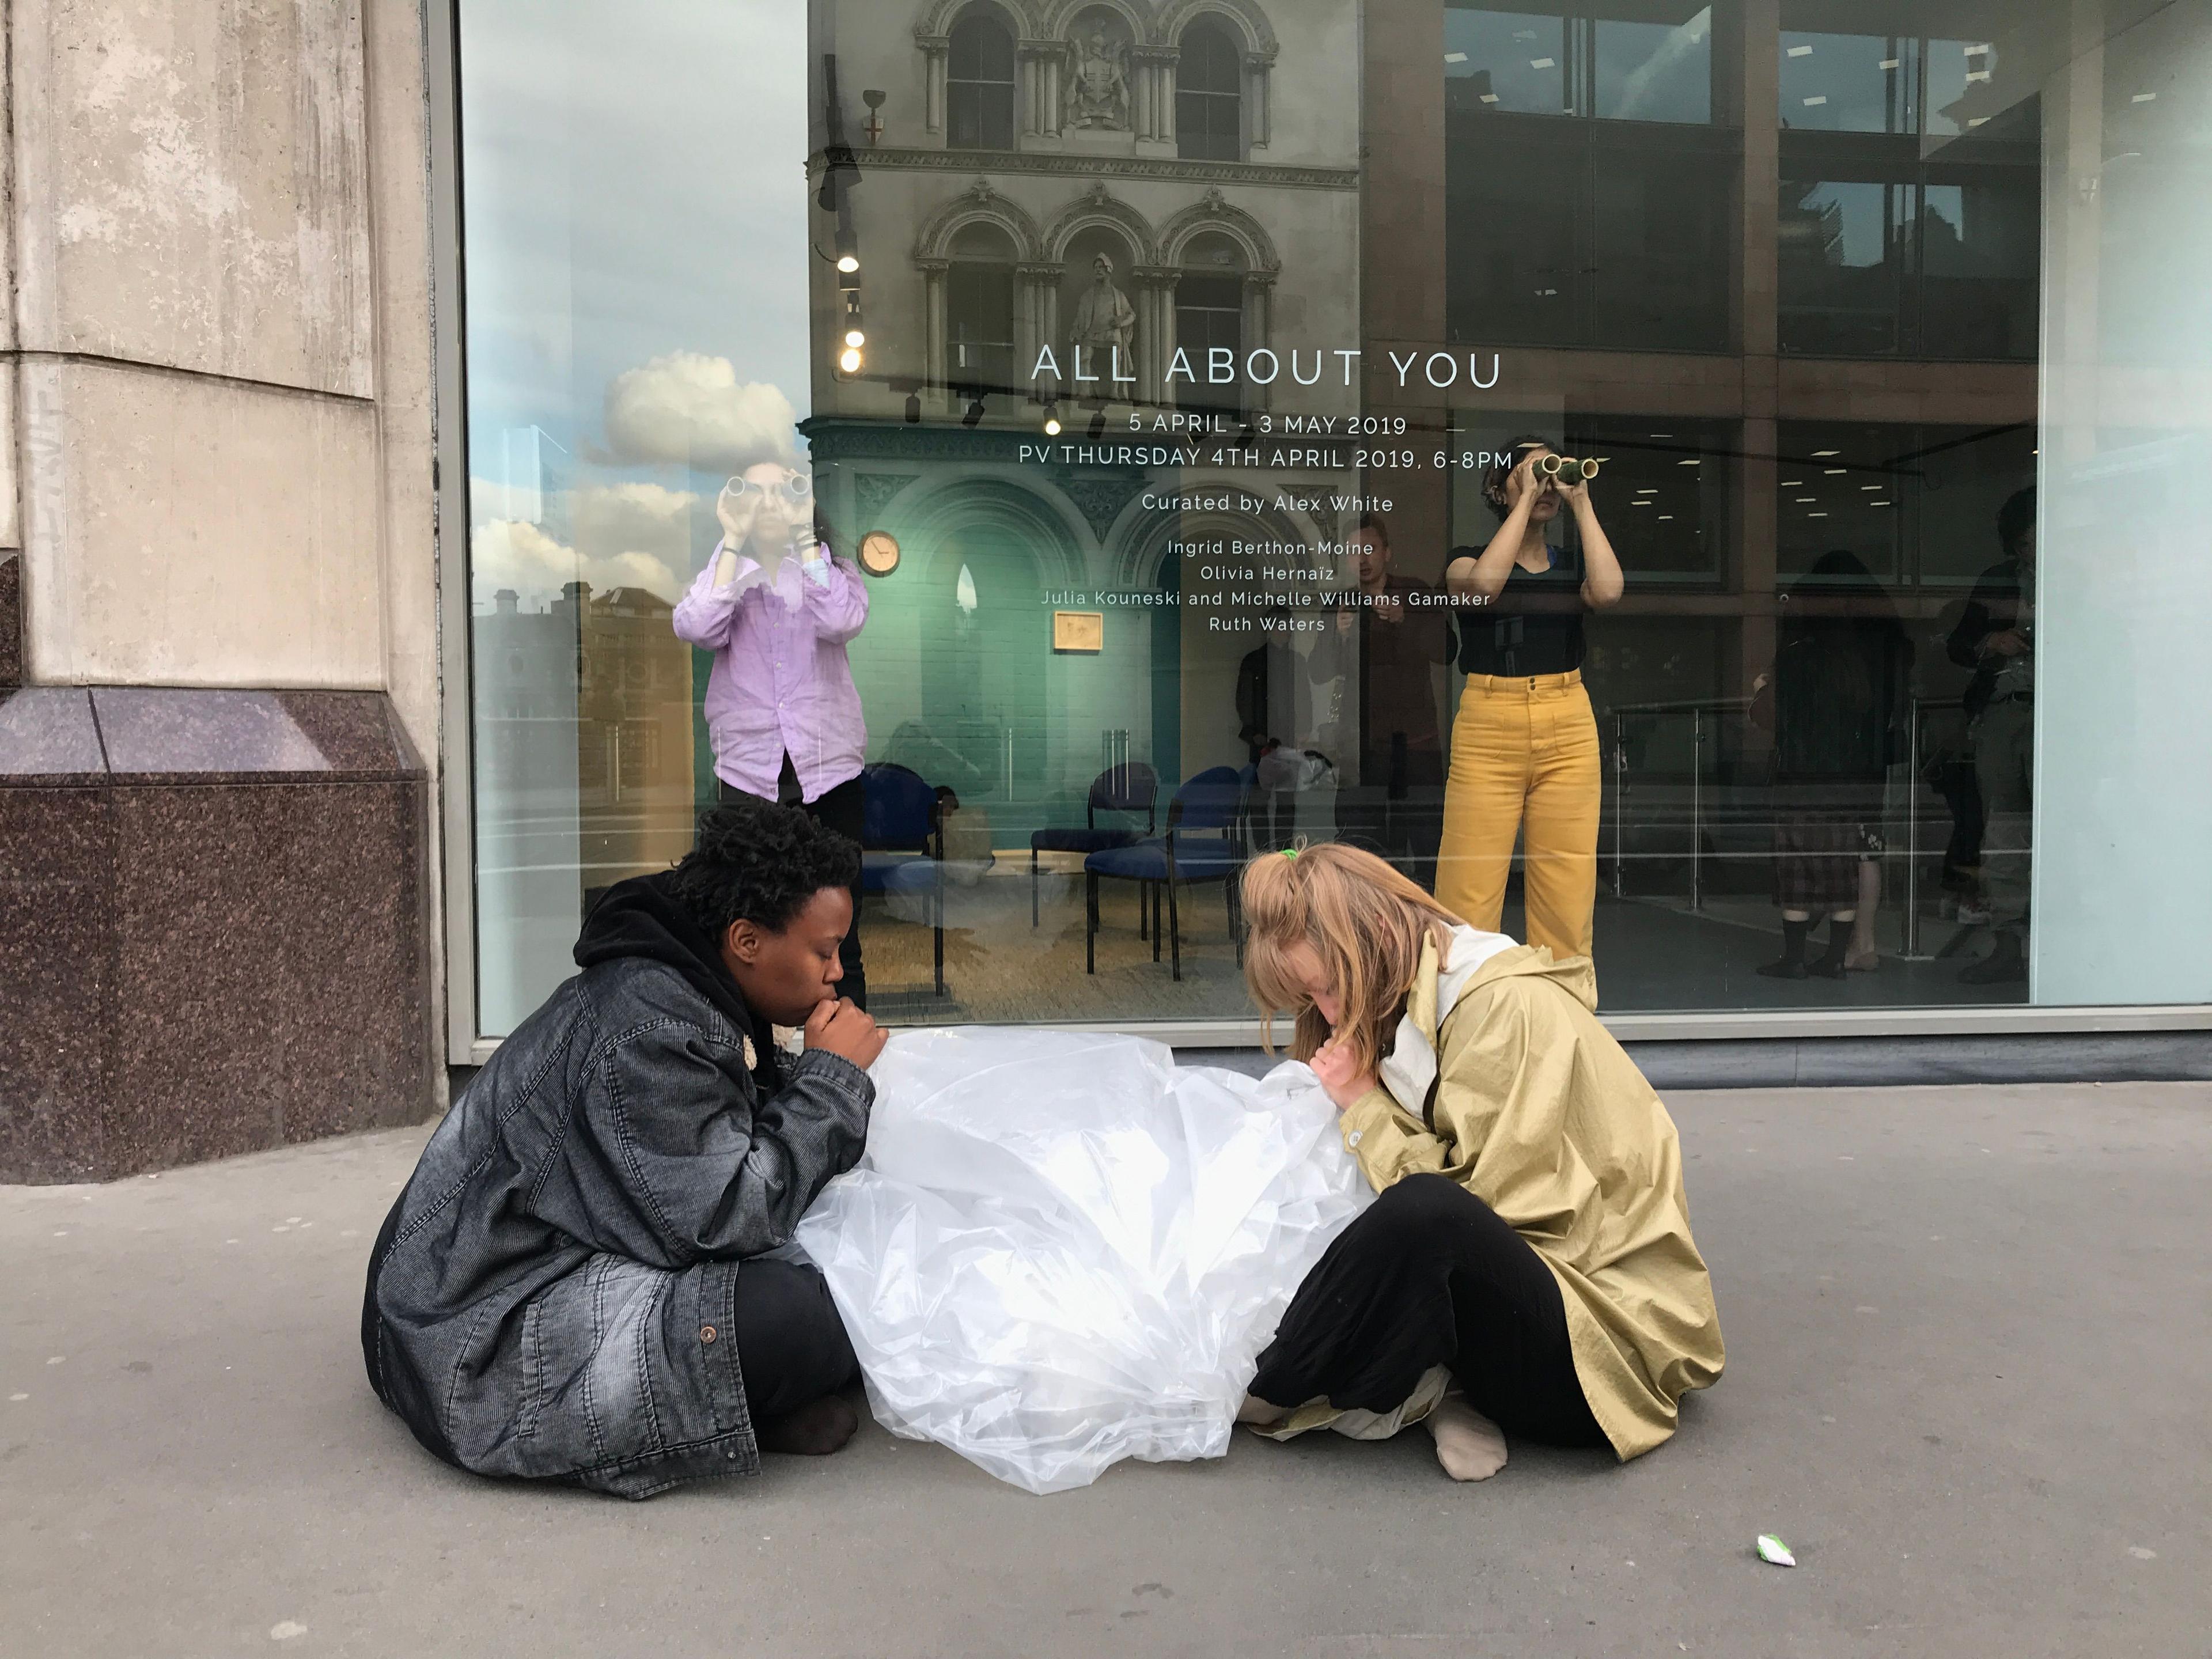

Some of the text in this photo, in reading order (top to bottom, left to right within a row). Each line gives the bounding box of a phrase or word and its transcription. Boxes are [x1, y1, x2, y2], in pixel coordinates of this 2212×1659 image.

[1031, 344, 1499, 389] ALL ABOUT YOU
[1129, 414, 1141, 431] 5
[1153, 414, 1227, 433] APRIL
[1259, 416, 1272, 433] 3
[1285, 416, 1336, 434] MAY
[1348, 417, 1406, 435] 2019
[1019, 446, 1512, 469] PV THURSDAY 4TH APRIL 2019, 6-8PM
[1142, 494, 1393, 514] Curated by Alex White
[1168, 540, 1373, 558] Ingrid Berthon-Moine
[1200, 566, 1334, 581] Olivia Hernaïz
[1041, 590, 1491, 607] Julia Kouneski and Michelle Williams Gamaker
[1209, 617, 1325, 631] Ruth Waters
